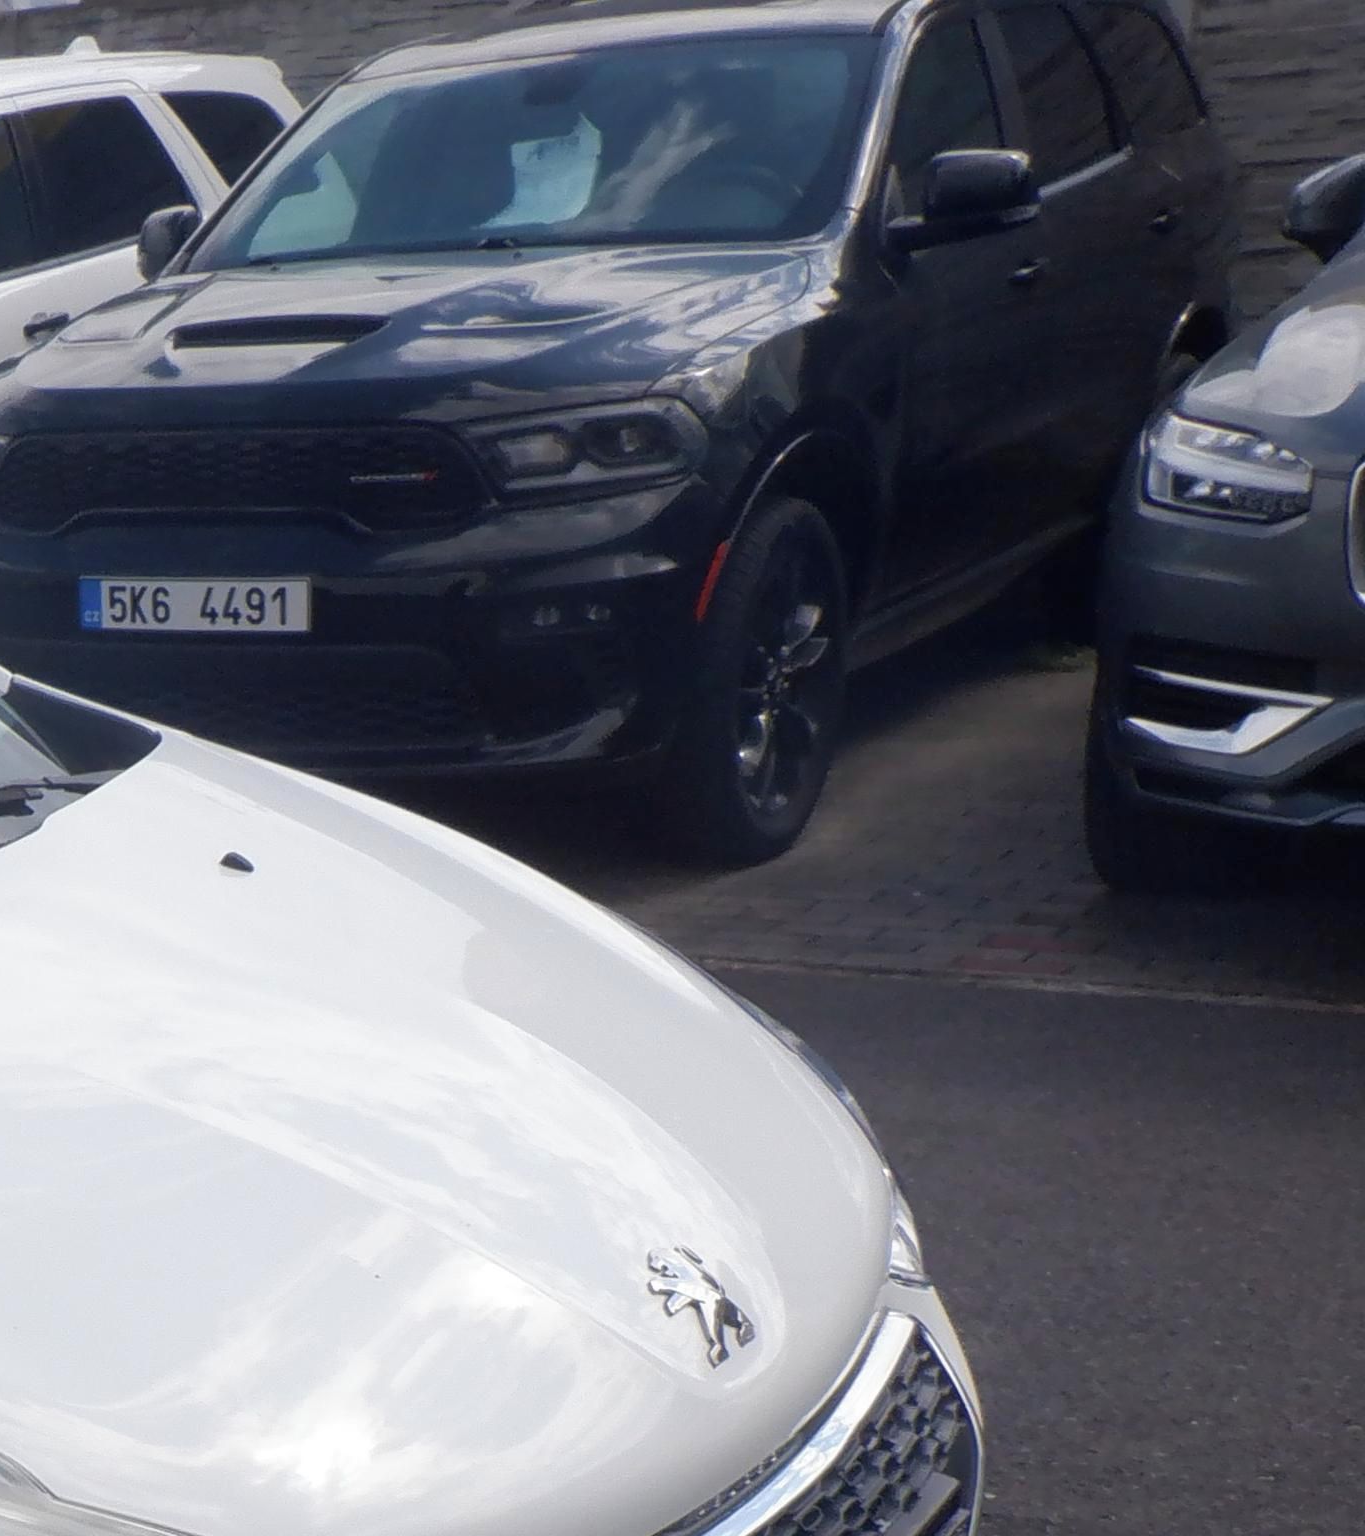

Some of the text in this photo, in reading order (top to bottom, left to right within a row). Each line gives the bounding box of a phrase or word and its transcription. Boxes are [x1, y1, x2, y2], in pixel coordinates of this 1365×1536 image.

[84, 585, 287, 626] CZ 5K6 4491
